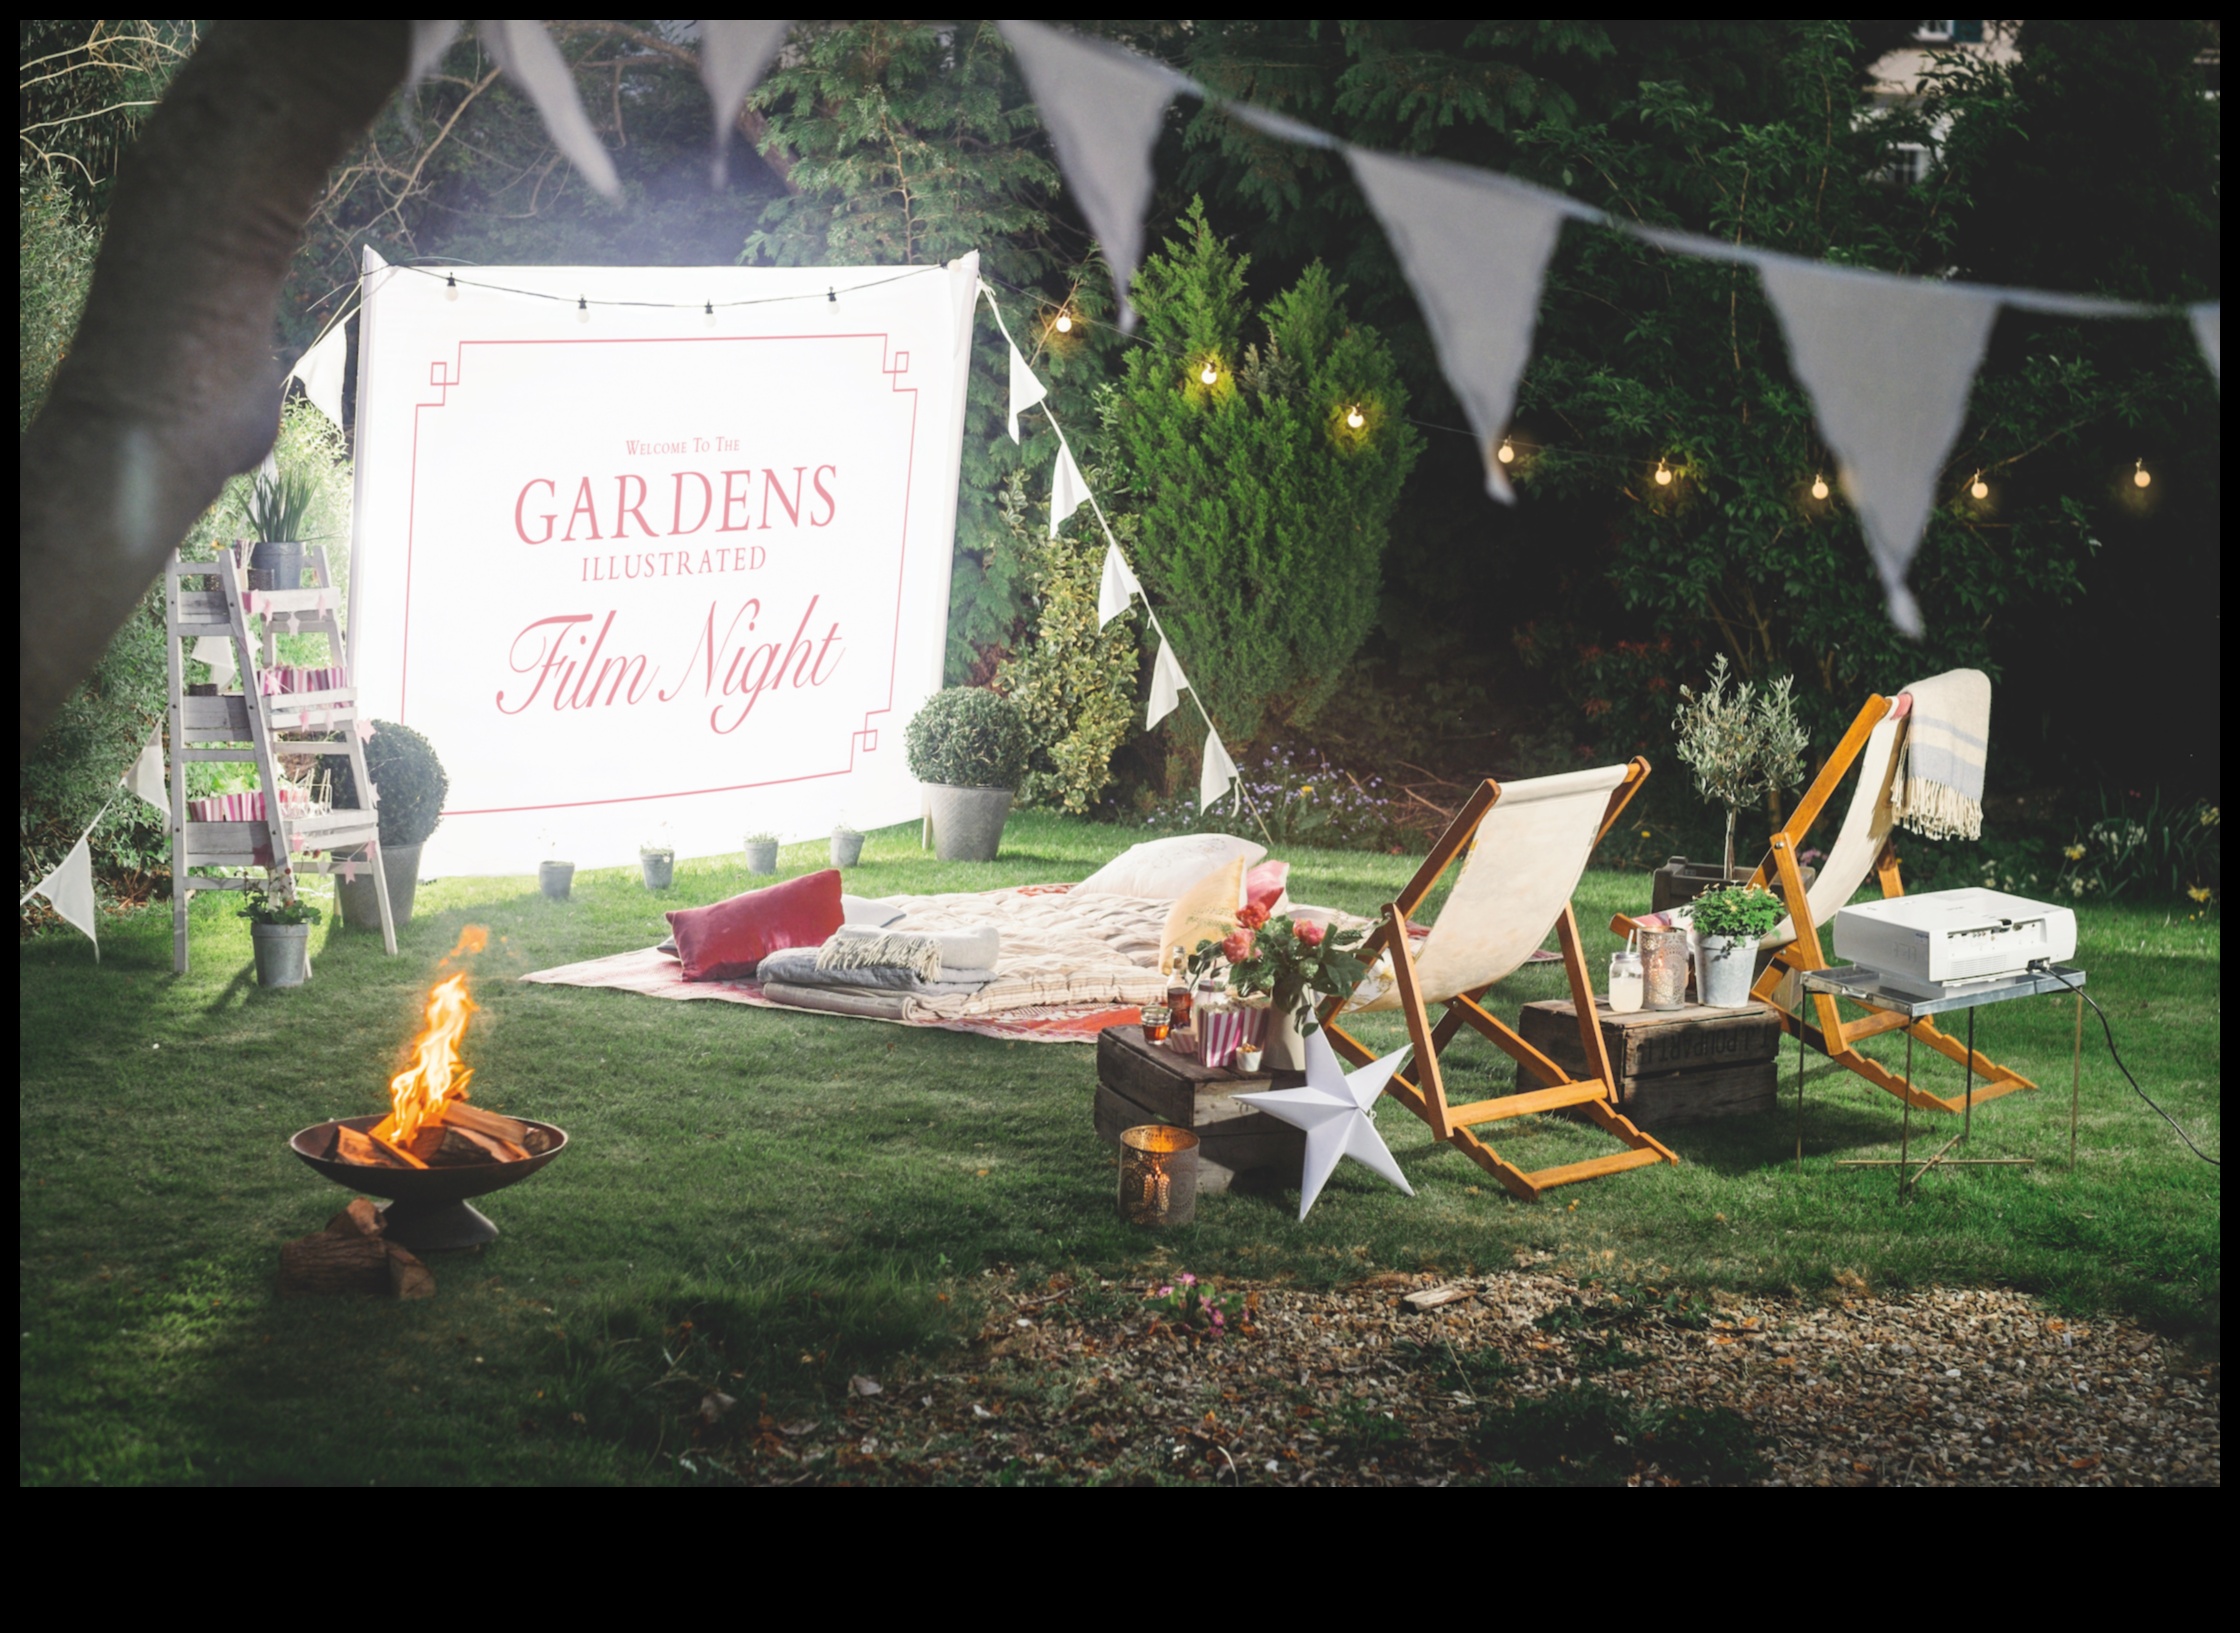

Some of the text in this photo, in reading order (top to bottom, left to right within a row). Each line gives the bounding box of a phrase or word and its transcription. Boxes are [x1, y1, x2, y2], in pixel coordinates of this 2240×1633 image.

[514, 464, 837, 545] GARDENS
[581, 545, 767, 582] ILLUSTRATED
[496, 594, 846, 735] Film Night
